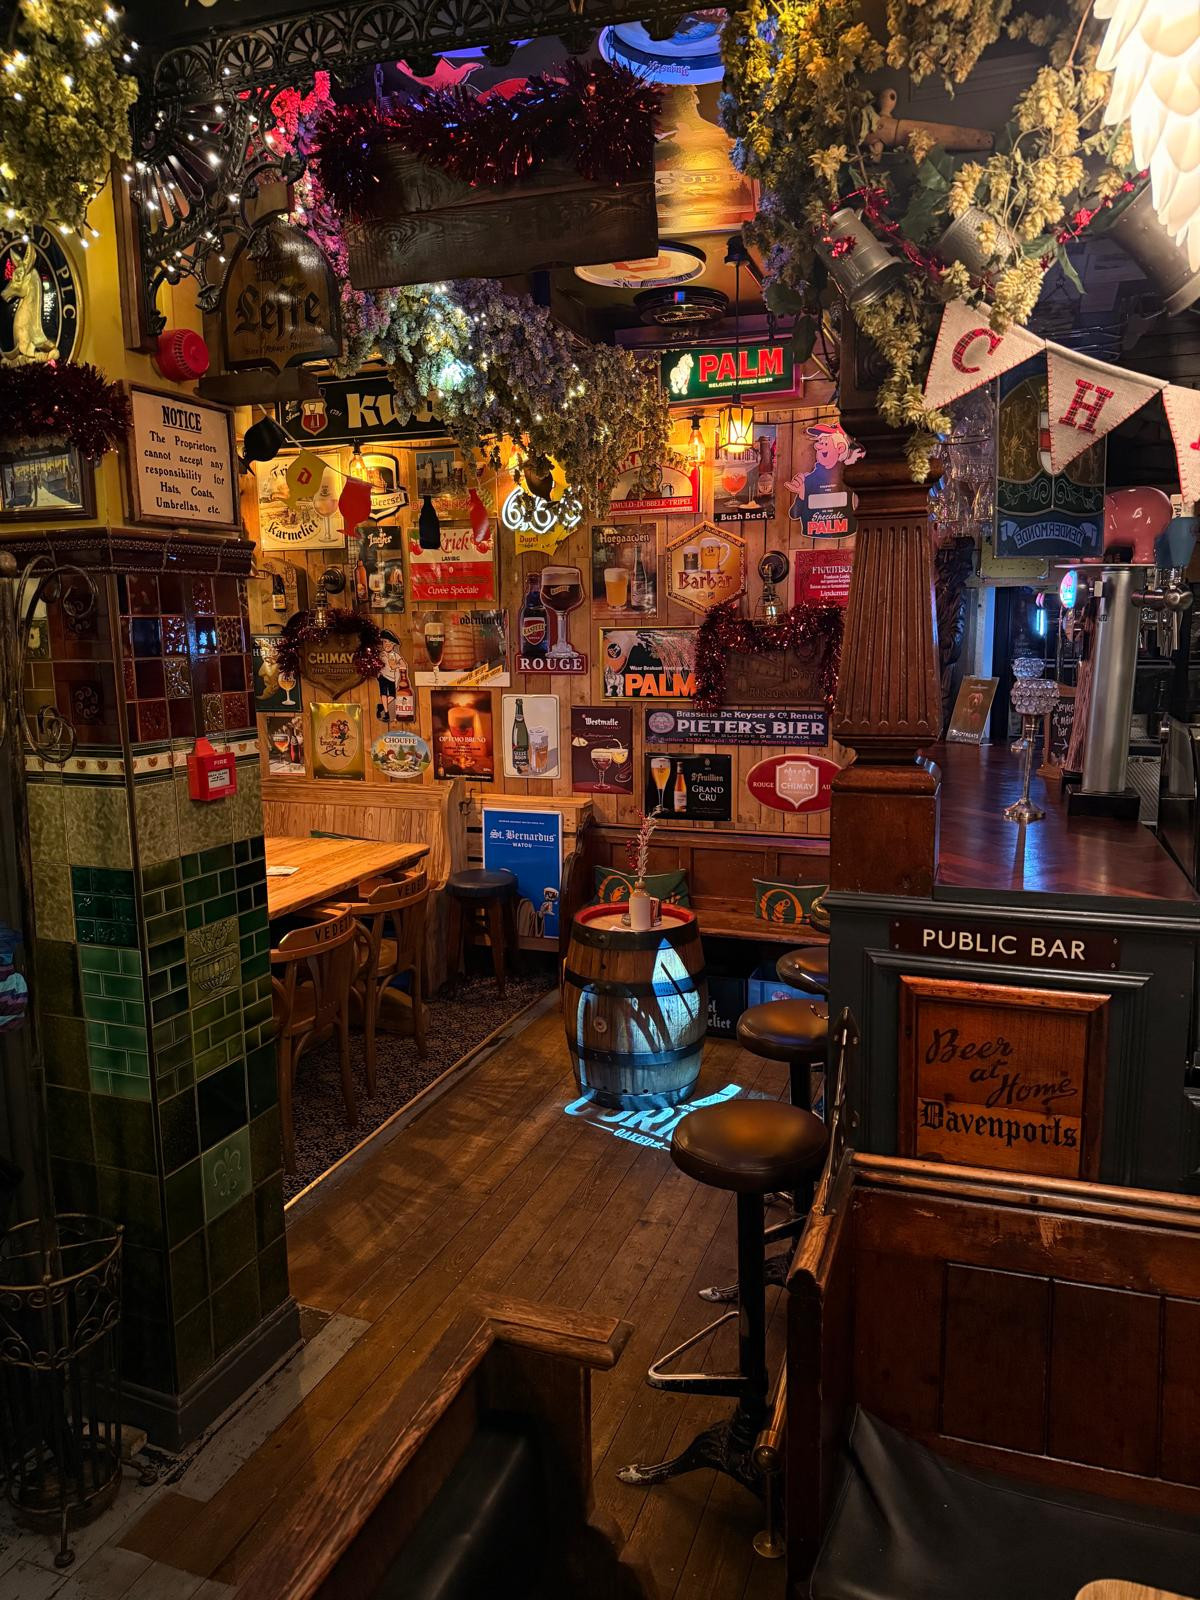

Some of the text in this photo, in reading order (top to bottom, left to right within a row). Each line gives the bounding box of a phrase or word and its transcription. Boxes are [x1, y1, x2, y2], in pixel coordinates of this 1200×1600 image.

[56, 264, 76, 319] PLC
[699, 347, 784, 382] PALM
[952, 328, 1115, 434] C H
[161, 405, 202, 432] NOTICE
[149, 430, 217, 453] The Proprietors
[144, 449, 224, 471] cannot accept any
[145, 465, 225, 485] responsibility for
[160, 481, 215, 500] Hats, Coats,
[156, 497, 221, 514] Umbrellas, etc.
[720, 512, 743, 521] Bush
[811, 511, 846, 523] Speciale
[267, 519, 319, 541] Karmeliet
[807, 517, 849, 535] PALM
[599, 533, 650, 545] Hoegaarden
[428, 585, 450, 595] Cuvée
[308, 652, 355, 664] CHIMAY
[519, 657, 583, 671] ROUGE
[625, 673, 697, 697] PALM
[585, 717, 619, 726] Westmalle
[734, 711, 767, 720] Keyser
[790, 712, 823, 720] Renaix
[772, 722, 825, 736] BIER
[384, 737, 417, 745] CHOUFFE
[213, 758, 228, 766] FIRE
[691, 785, 724, 794] GRAND
[781, 782, 814, 790] CHIMAY
[698, 793, 717, 802] CRU
[505, 829, 555, 842] Bernardus
[923, 928, 1085, 960] PUBLIC BAR
[925, 1028, 1014, 1064] Beer
[969, 1060, 1008, 1083] at
[985, 1072, 1079, 1109] Home
[920, 1100, 1079, 1148] Davenports
[613, 1128, 655, 1148] OAKED
